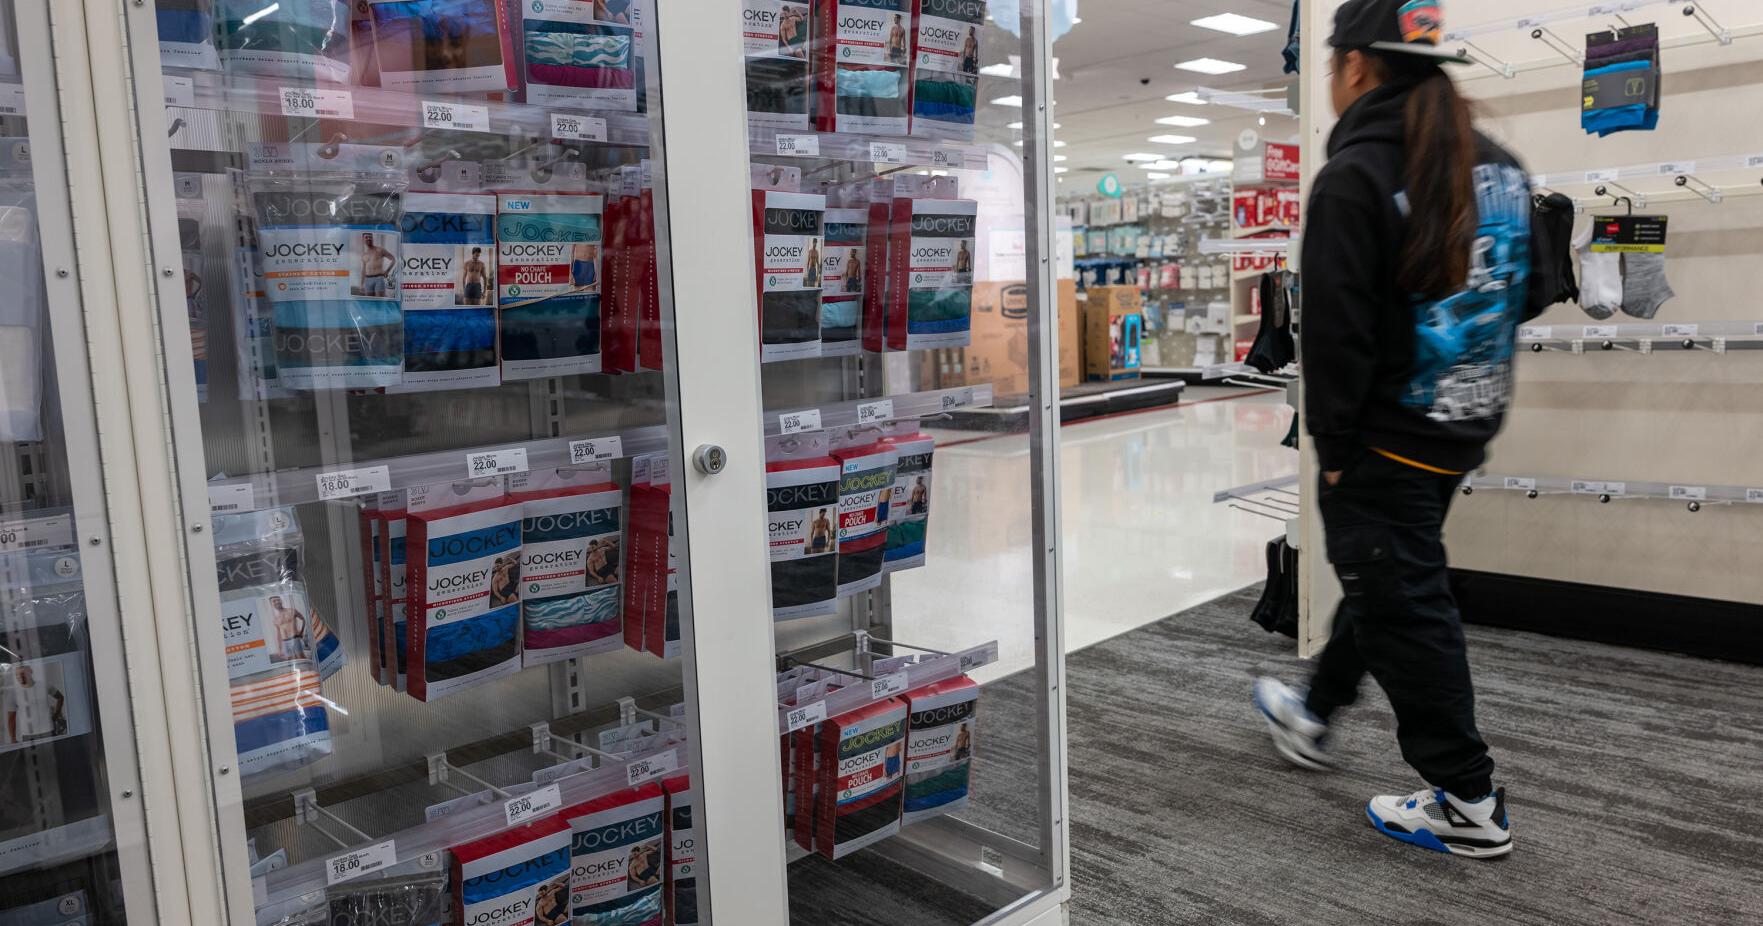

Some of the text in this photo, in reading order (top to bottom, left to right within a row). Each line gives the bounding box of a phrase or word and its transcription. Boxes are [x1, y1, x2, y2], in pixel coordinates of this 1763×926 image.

[743, 9, 777, 23] CKEY
[838, 17, 885, 32] JOCKEY
[920, 26, 961, 41] JOCKEY
[286, 98, 315, 109] 18.00
[427, 111, 452, 122] 22.00
[556, 123, 579, 134] 22.00
[778, 142, 797, 151] 22.00
[278, 198, 382, 218] JOCKEY
[507, 201, 530, 210] NEW
[401, 214, 484, 233] OCKEY
[912, 217, 972, 233] JOCKEY
[265, 243, 346, 257] JOCKEY
[502, 244, 565, 256] JOCKEY
[765, 246, 804, 258] JOCKEY
[911, 248, 953, 258] JOCKEY
[510, 257, 562, 265] generation
[824, 256, 841, 267] KEY
[515, 272, 552, 284] POUCH
[275, 333, 377, 353] JOCKEY
[860, 409, 876, 420] 22.00
[784, 419, 801, 430] 22.00
[574, 447, 595, 458] 22.00
[473, 459, 497, 471] 22.00
[845, 463, 859, 471] NEW
[321, 479, 350, 492] 18.00
[840, 471, 893, 491] JOCKEY
[767, 484, 831, 506] OCKEY
[840, 493, 876, 507] JOCKEY
[523, 508, 615, 533] JOCKEY
[769, 520, 803, 533] CKEY
[845, 516, 867, 527] POUCH
[430, 526, 516, 558] JOCKEY
[64, 560, 69, 568] L
[522, 549, 584, 566] JOCKEY
[429, 569, 489, 591] JOCKEY
[790, 713, 807, 724] 22.00
[912, 702, 970, 724] JOCKEY
[842, 721, 901, 752] JOCKEY
[844, 727, 860, 737] NEW
[909, 735, 952, 750] JOCKEY
[840, 751, 882, 771] JOCKEY
[630, 765, 650, 778] 22.00
[848, 773, 873, 787] POUCH
[509, 802, 532, 816] 22.00
[571, 812, 660, 851] JOCKEY
[333, 859, 360, 874] 18.00
[467, 897, 532, 926] JOCKEY
